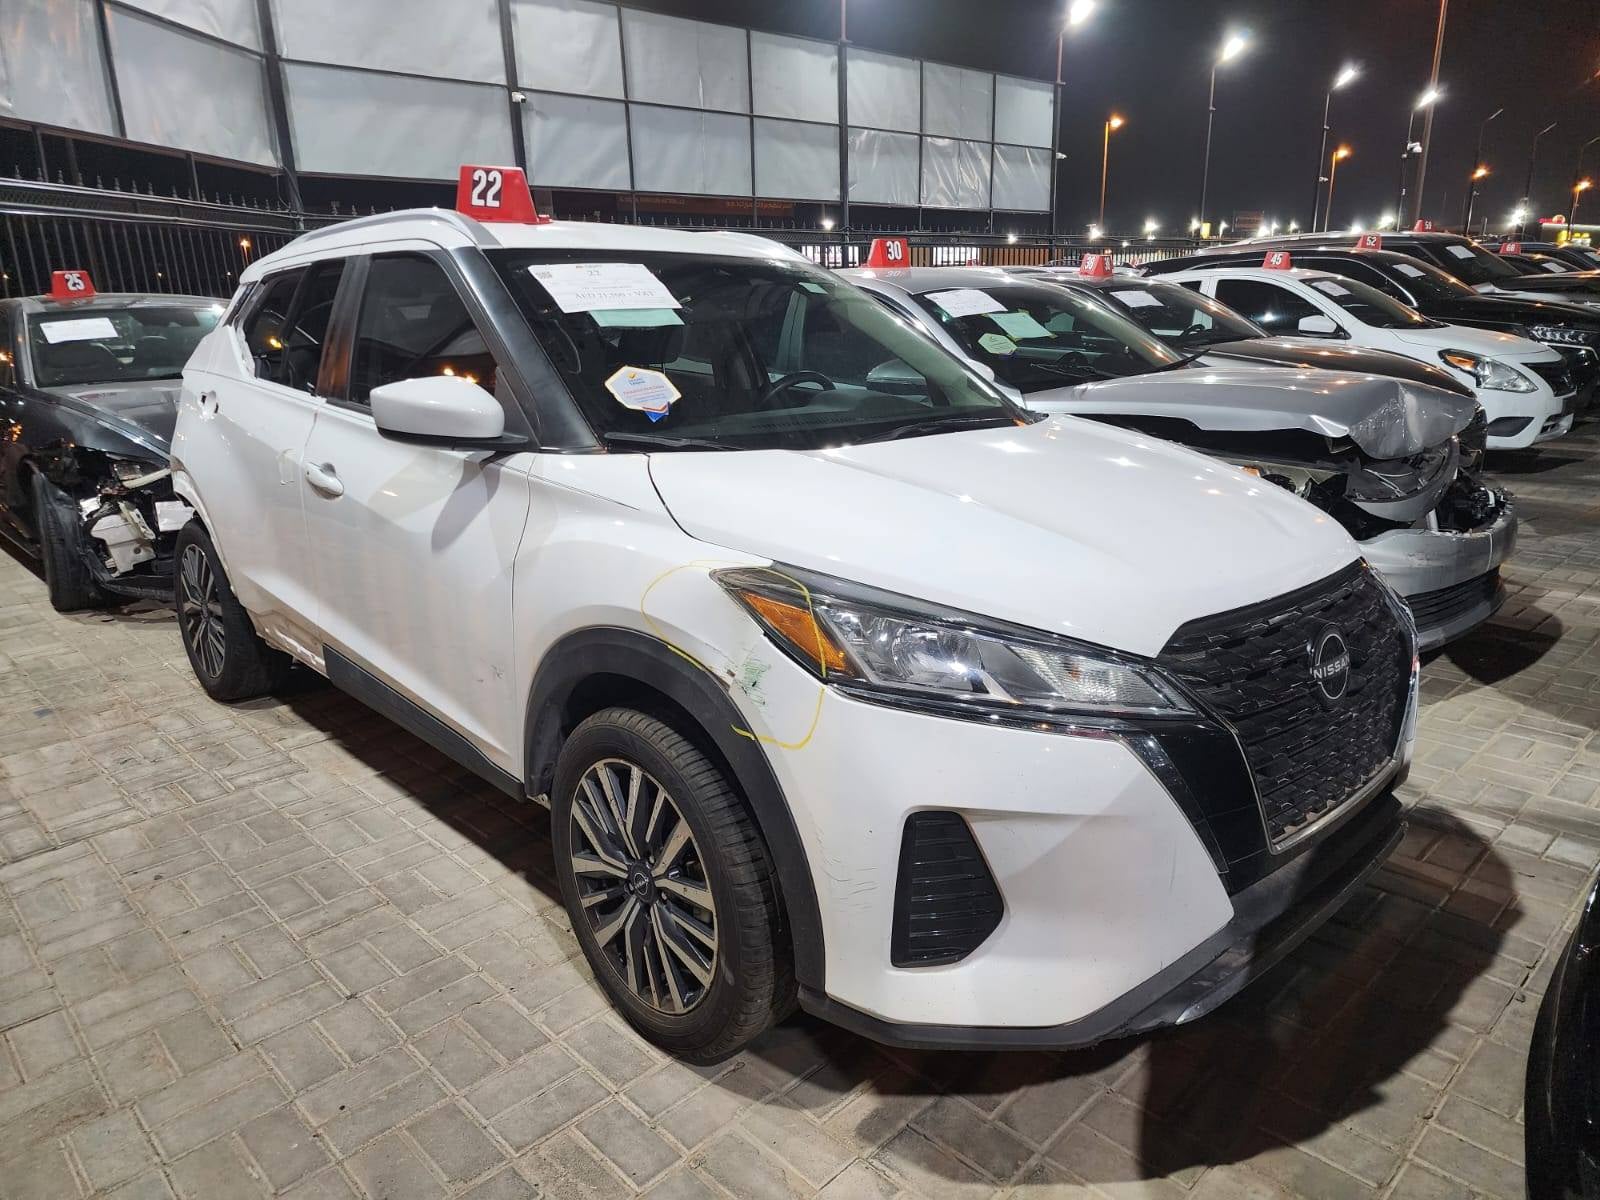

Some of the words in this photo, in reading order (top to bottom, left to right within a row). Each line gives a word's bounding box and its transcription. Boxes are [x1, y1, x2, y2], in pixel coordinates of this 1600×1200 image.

[471, 169, 502, 208] 22
[1366, 235, 1377, 247] 52
[886, 241, 903, 260] 30
[1270, 253, 1283, 265] 45
[64, 273, 85, 291] 25
[1313, 655, 1350, 679] NISSAN
